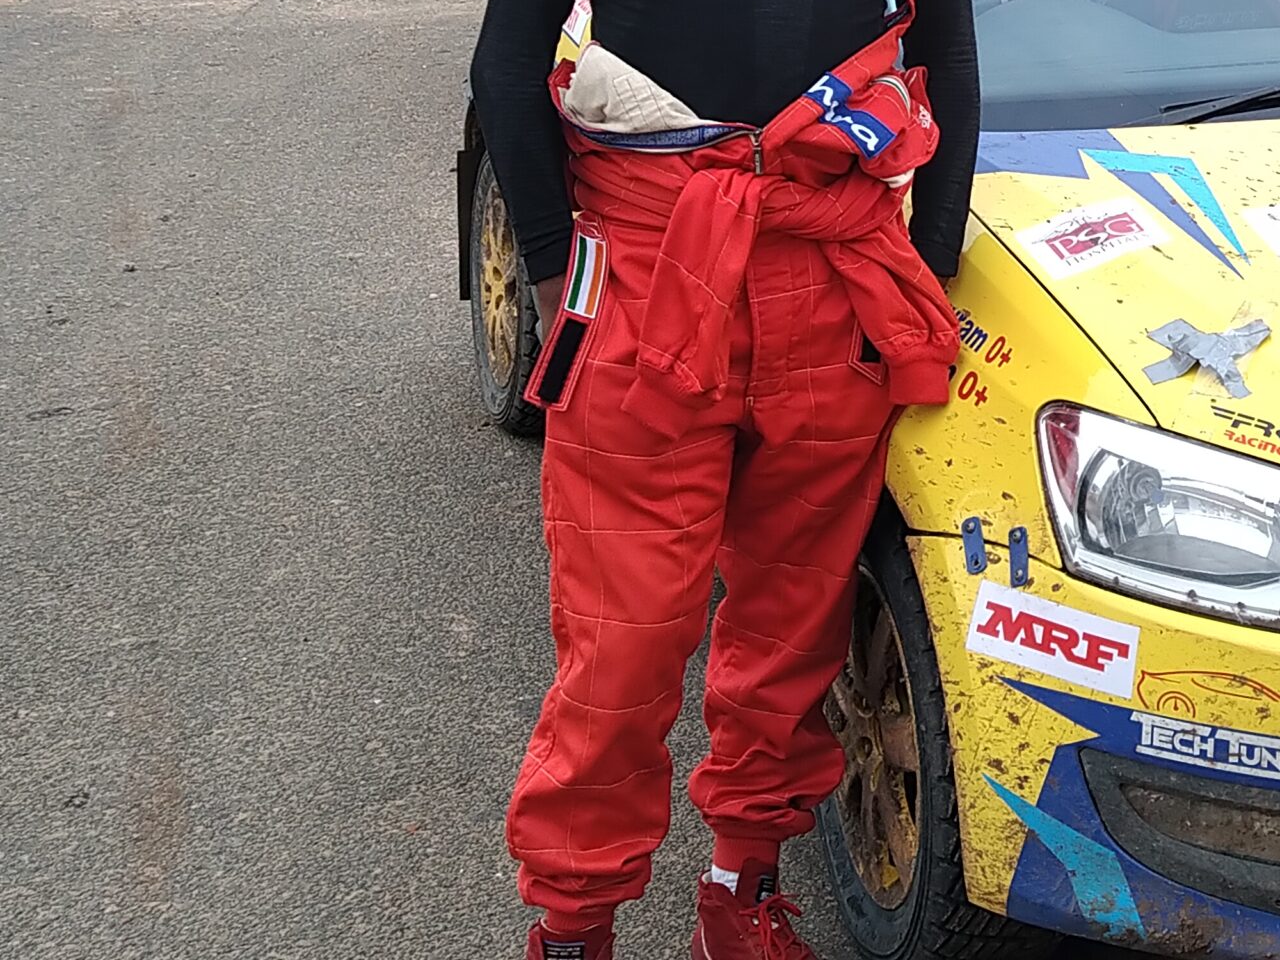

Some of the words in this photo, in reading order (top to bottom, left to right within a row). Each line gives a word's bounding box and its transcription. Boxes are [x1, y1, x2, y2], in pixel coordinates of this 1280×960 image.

[1049, 216, 1143, 260] PSG
[976, 600, 1130, 672] MRF
[1130, 711, 1214, 759] TECH
